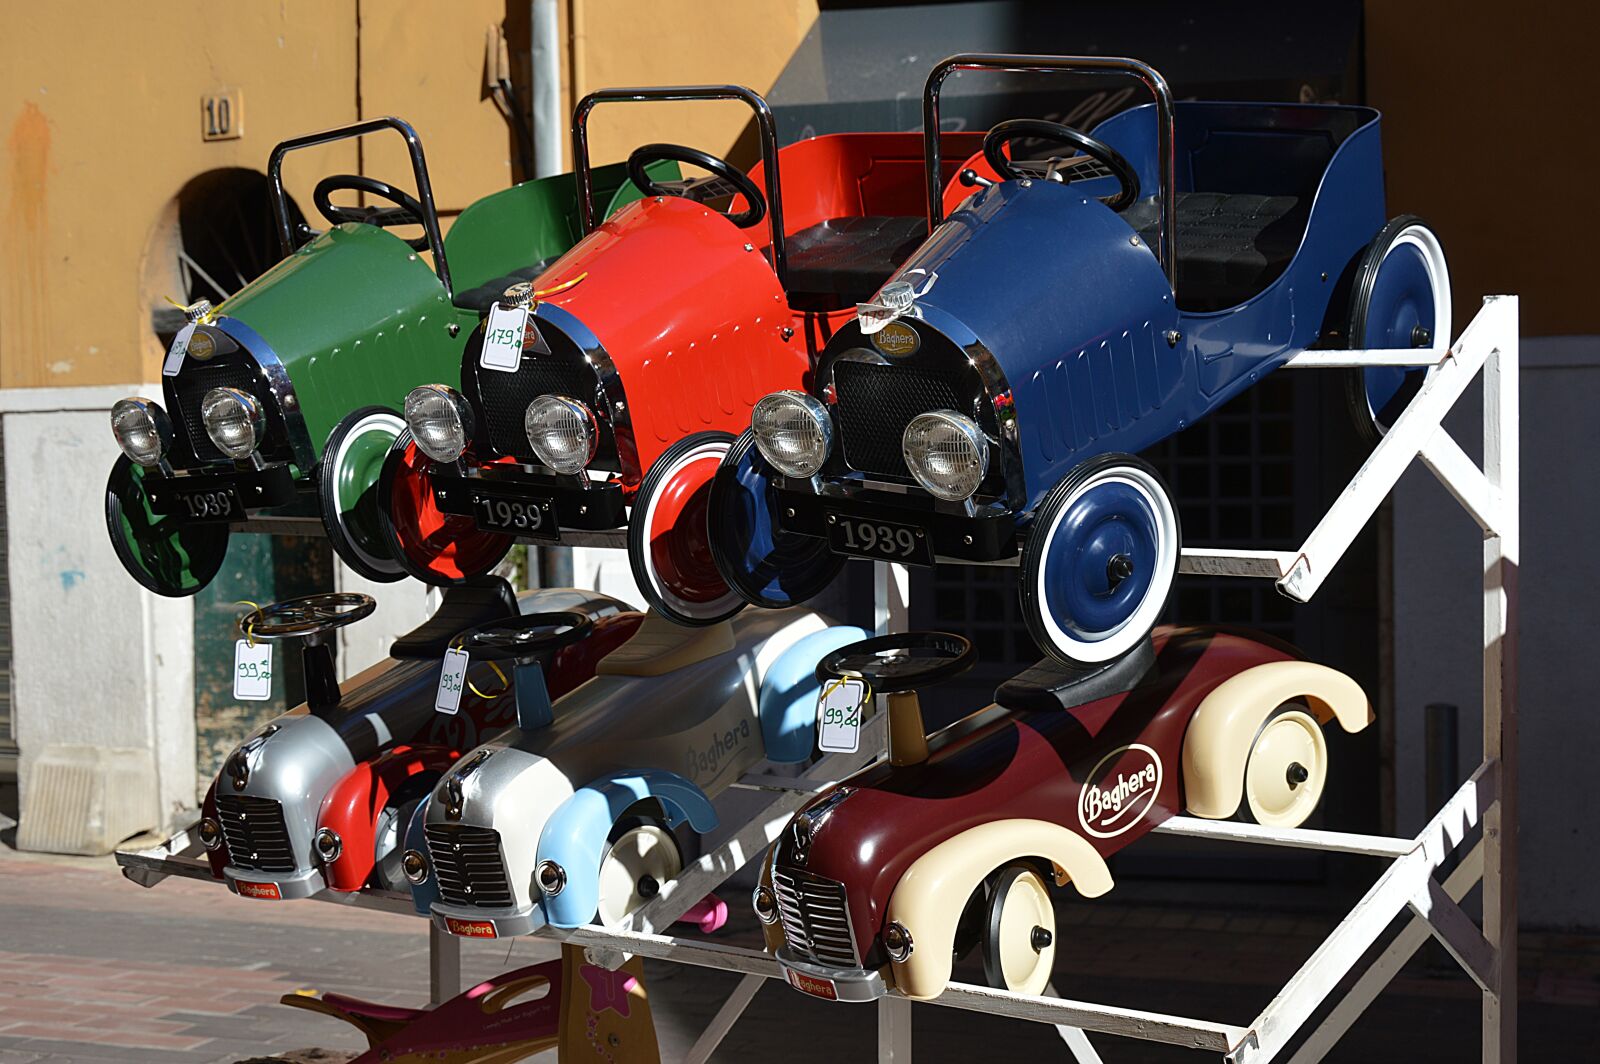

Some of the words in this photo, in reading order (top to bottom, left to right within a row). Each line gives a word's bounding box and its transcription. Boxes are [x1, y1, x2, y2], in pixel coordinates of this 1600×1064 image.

[207, 98, 230, 136] 10
[879, 329, 914, 348] Baghera
[183, 491, 232, 518] 1939
[482, 499, 542, 530] 1939
[840, 520, 915, 557] 1939
[686, 718, 750, 780] Baghera
[1084, 763, 1156, 824] Baghera
[450, 920, 493, 936] Baghera
